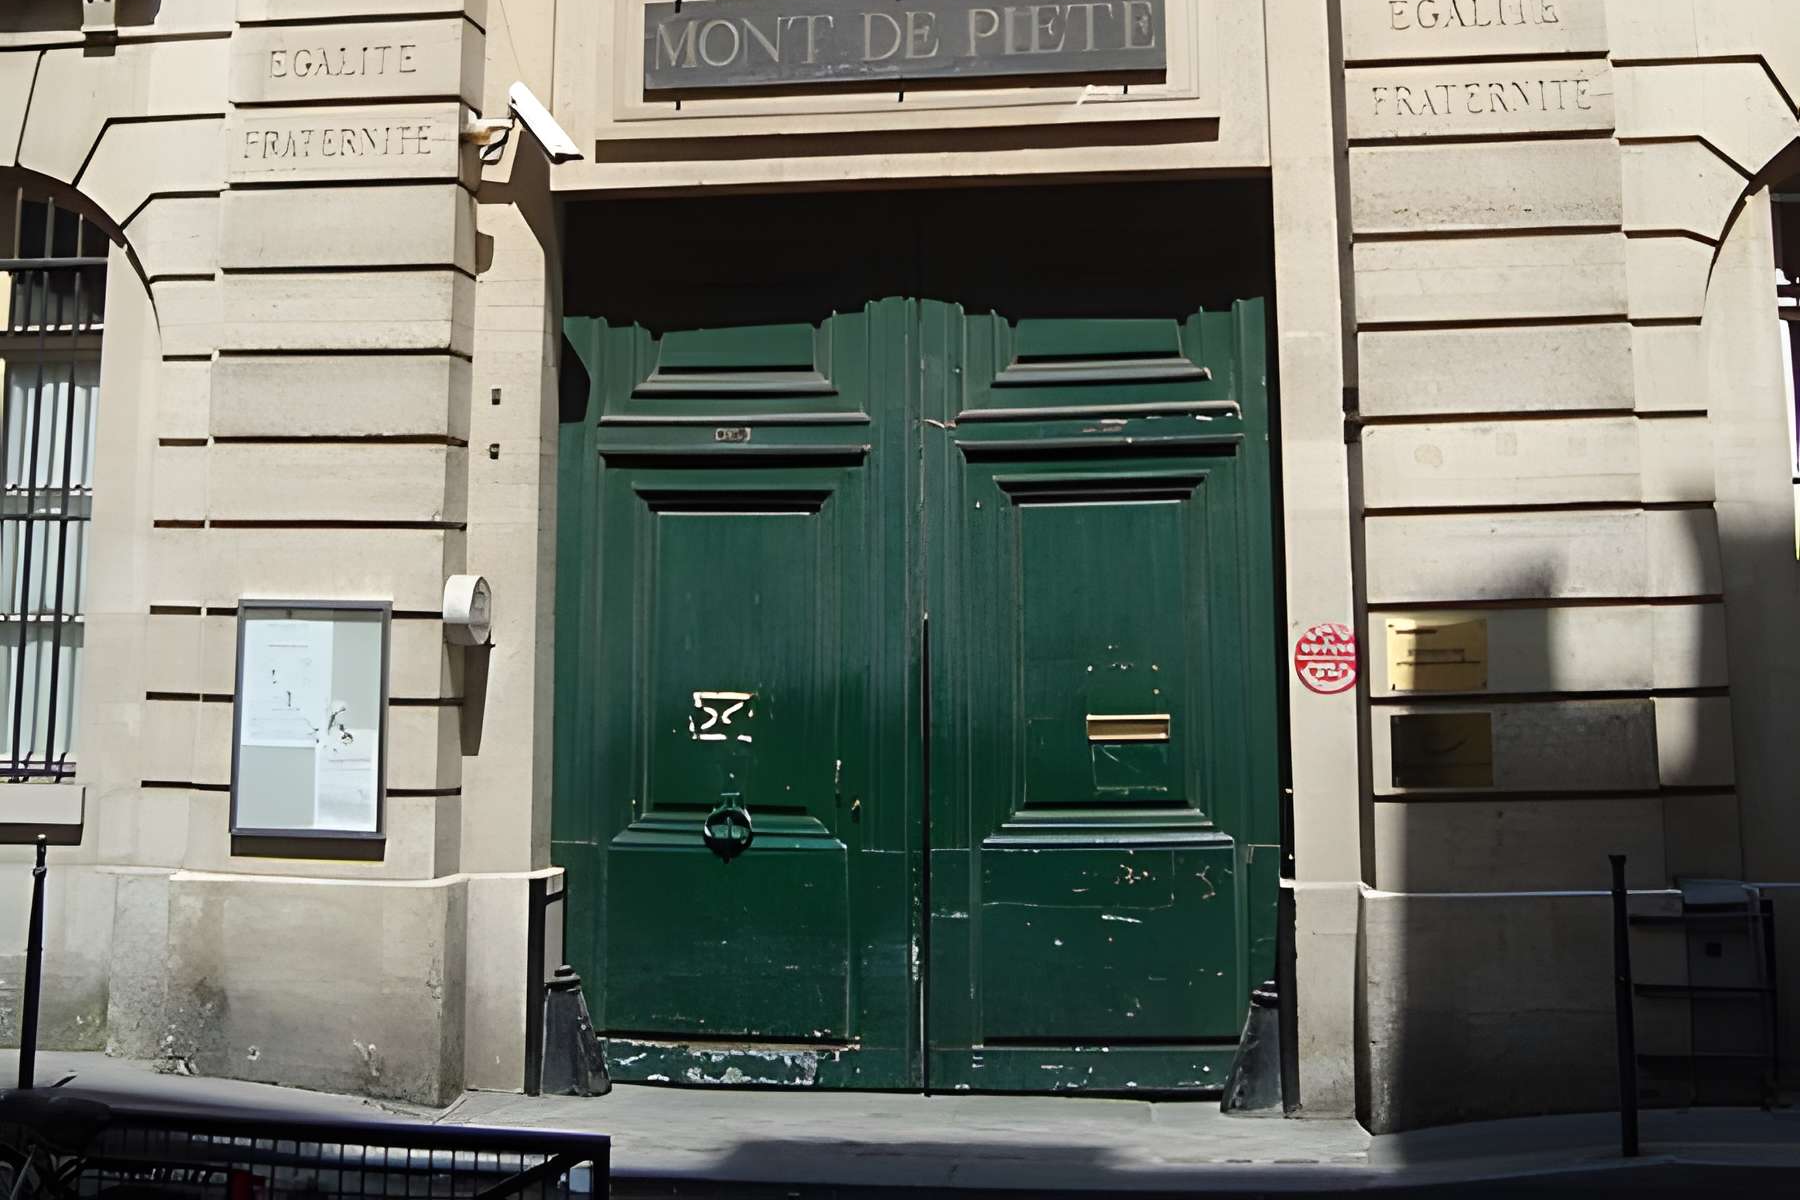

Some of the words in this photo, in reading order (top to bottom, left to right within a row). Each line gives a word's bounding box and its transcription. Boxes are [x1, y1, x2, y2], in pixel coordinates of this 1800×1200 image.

[270, 44, 417, 78] EGALITE
[655, 14, 834, 70] MONT
[859, 11, 940, 60] DE
